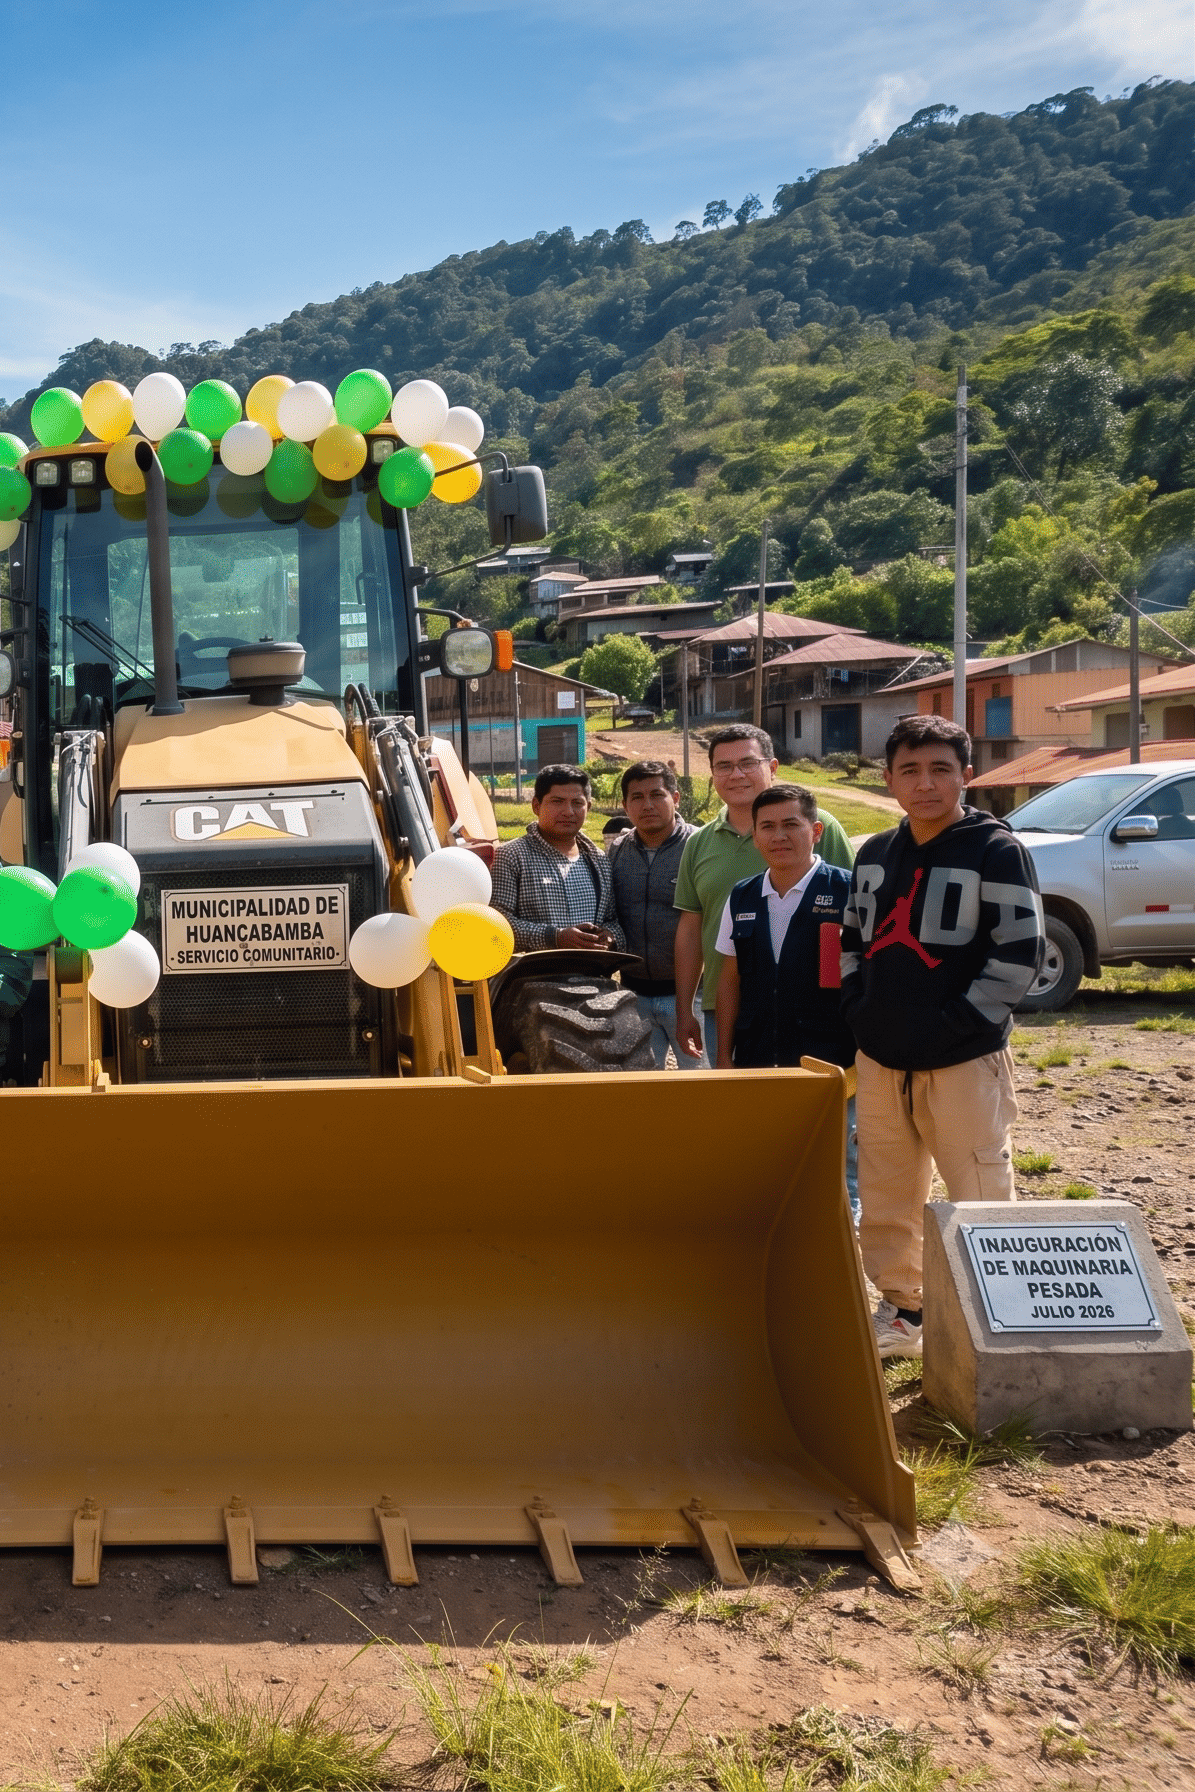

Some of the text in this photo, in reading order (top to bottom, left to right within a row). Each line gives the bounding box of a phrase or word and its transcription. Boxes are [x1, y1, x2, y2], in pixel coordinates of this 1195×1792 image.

[175, 801, 314, 840] CAT
[171, 895, 339, 919] MUNICIPALIDAD DE
[177, 949, 239, 964] SERVICIO
[979, 1233, 1122, 1253] INAUGURACIÓN
[983, 1259, 1133, 1276] DE MAQUINARIA
[1027, 1282, 1103, 1298] PESADA
[1031, 1305, 1115, 1319] JULIO 2026
